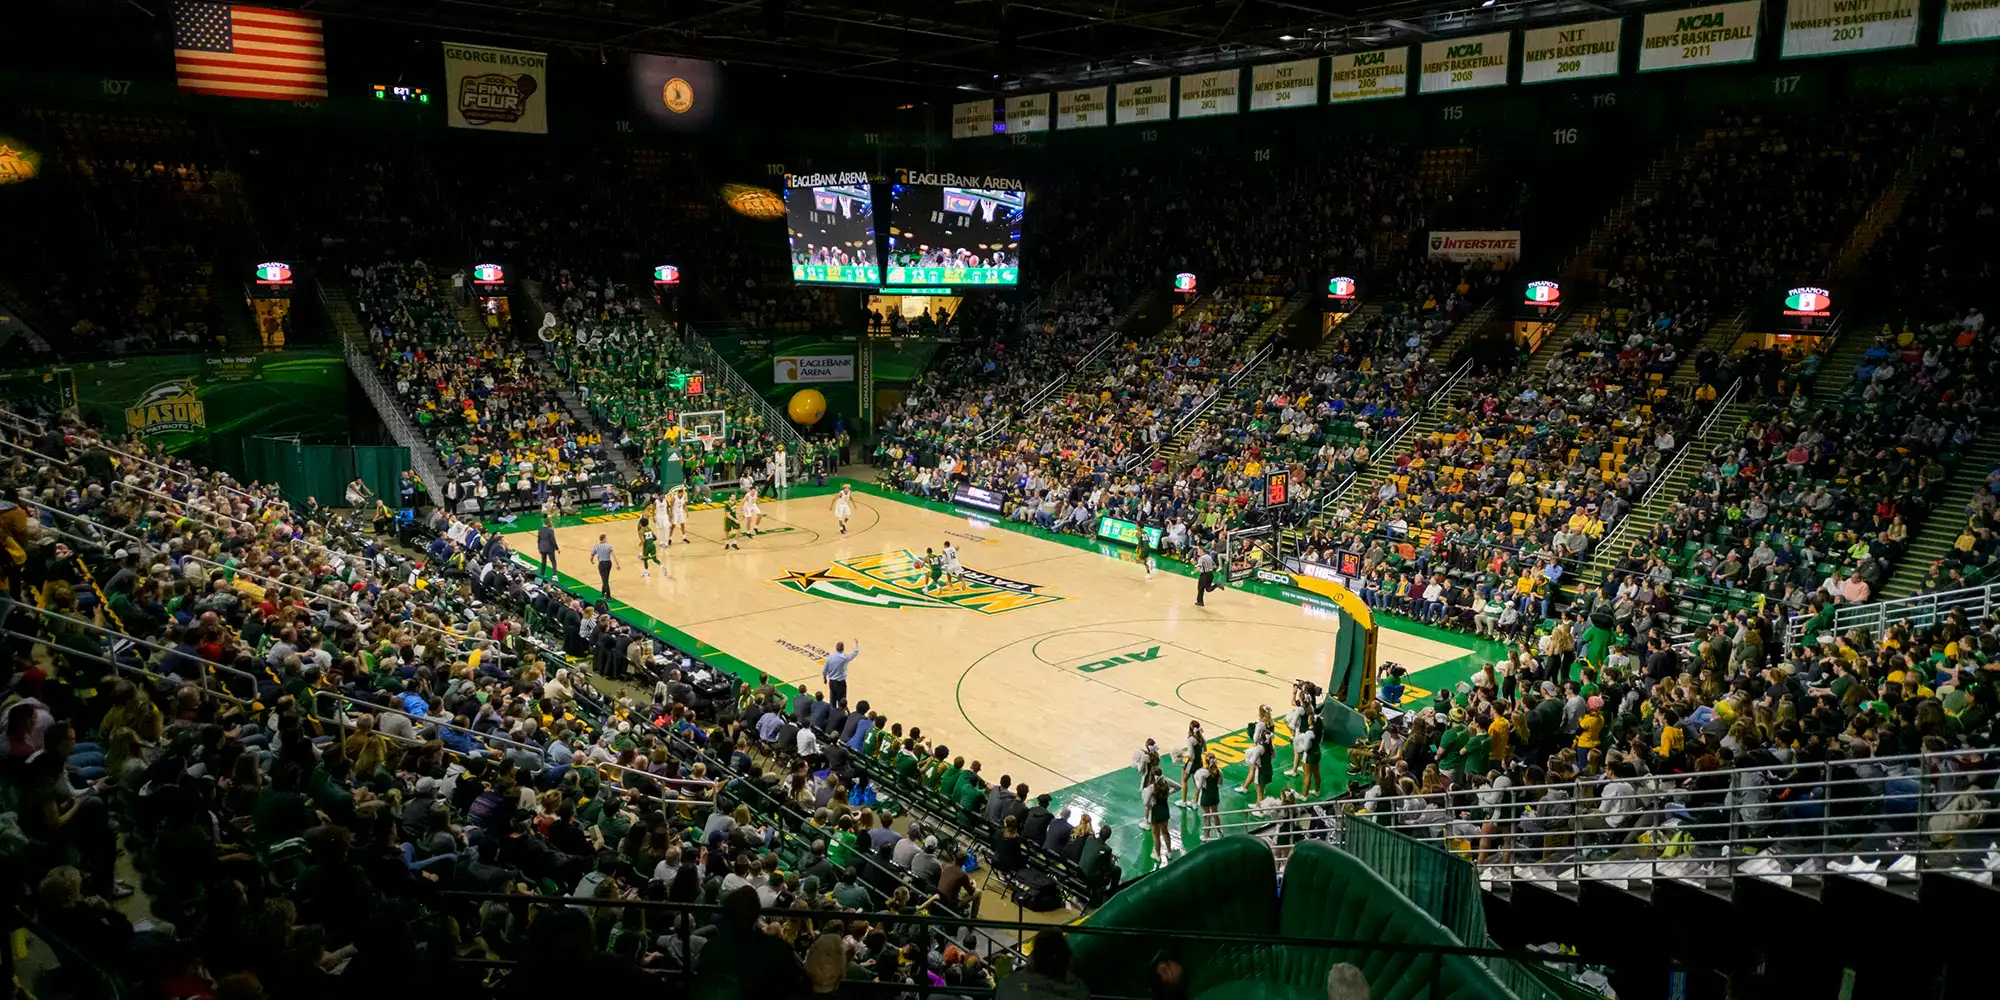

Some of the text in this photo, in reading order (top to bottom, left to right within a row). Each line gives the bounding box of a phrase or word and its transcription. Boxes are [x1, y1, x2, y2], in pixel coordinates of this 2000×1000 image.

[1676, 12, 1724, 32] NCAA
[1790, 8, 1913, 30] WOMEN'S BASKETBALL
[1558, 29, 1585, 44] NIT
[1645, 26, 1752, 49] MEN'S BASKETBALL
[1832, 26, 1864, 41] 2001
[445, 48, 545, 68] GEORGE MASON
[1446, 42, 1483, 59] NCAA
[1526, 41, 1615, 62] MEN'S BASKETBALL
[1682, 44, 1711, 59] 2011
[1353, 52, 1385, 67] NCAA
[1423, 55, 1504, 74] MEN'S BASKETBALL
[1556, 60, 1581, 73] 2009
[1276, 68, 1293, 78] NIT
[1333, 64, 1404, 82] MEN'S BASKETBALL
[1452, 71, 1473, 82] 2008
[98, 79, 133, 96] 107
[477, 83, 519, 96] FINAL
[1201, 78, 1218, 88] NIT
[1255, 78, 1315, 92] MEN'S BASKETBALL
[1773, 73, 1802, 94] 117
[464, 93, 519, 110] FOUR
[1592, 92, 1616, 109] 116
[1442, 105, 1463, 120] 115
[1011, 134, 1028, 145] 112
[1141, 130, 1158, 143] 113
[1553, 128, 1578, 145] 116
[1254, 148, 1271, 162] 114
[128, 401, 203, 429] MASON
[145, 423, 190, 433] PATRIOTS
[1257, 570, 1290, 584] GEICO
[1076, 644, 1161, 673] A10
[880, 739, 891, 754] 12
[925, 766, 934, 778] 4
